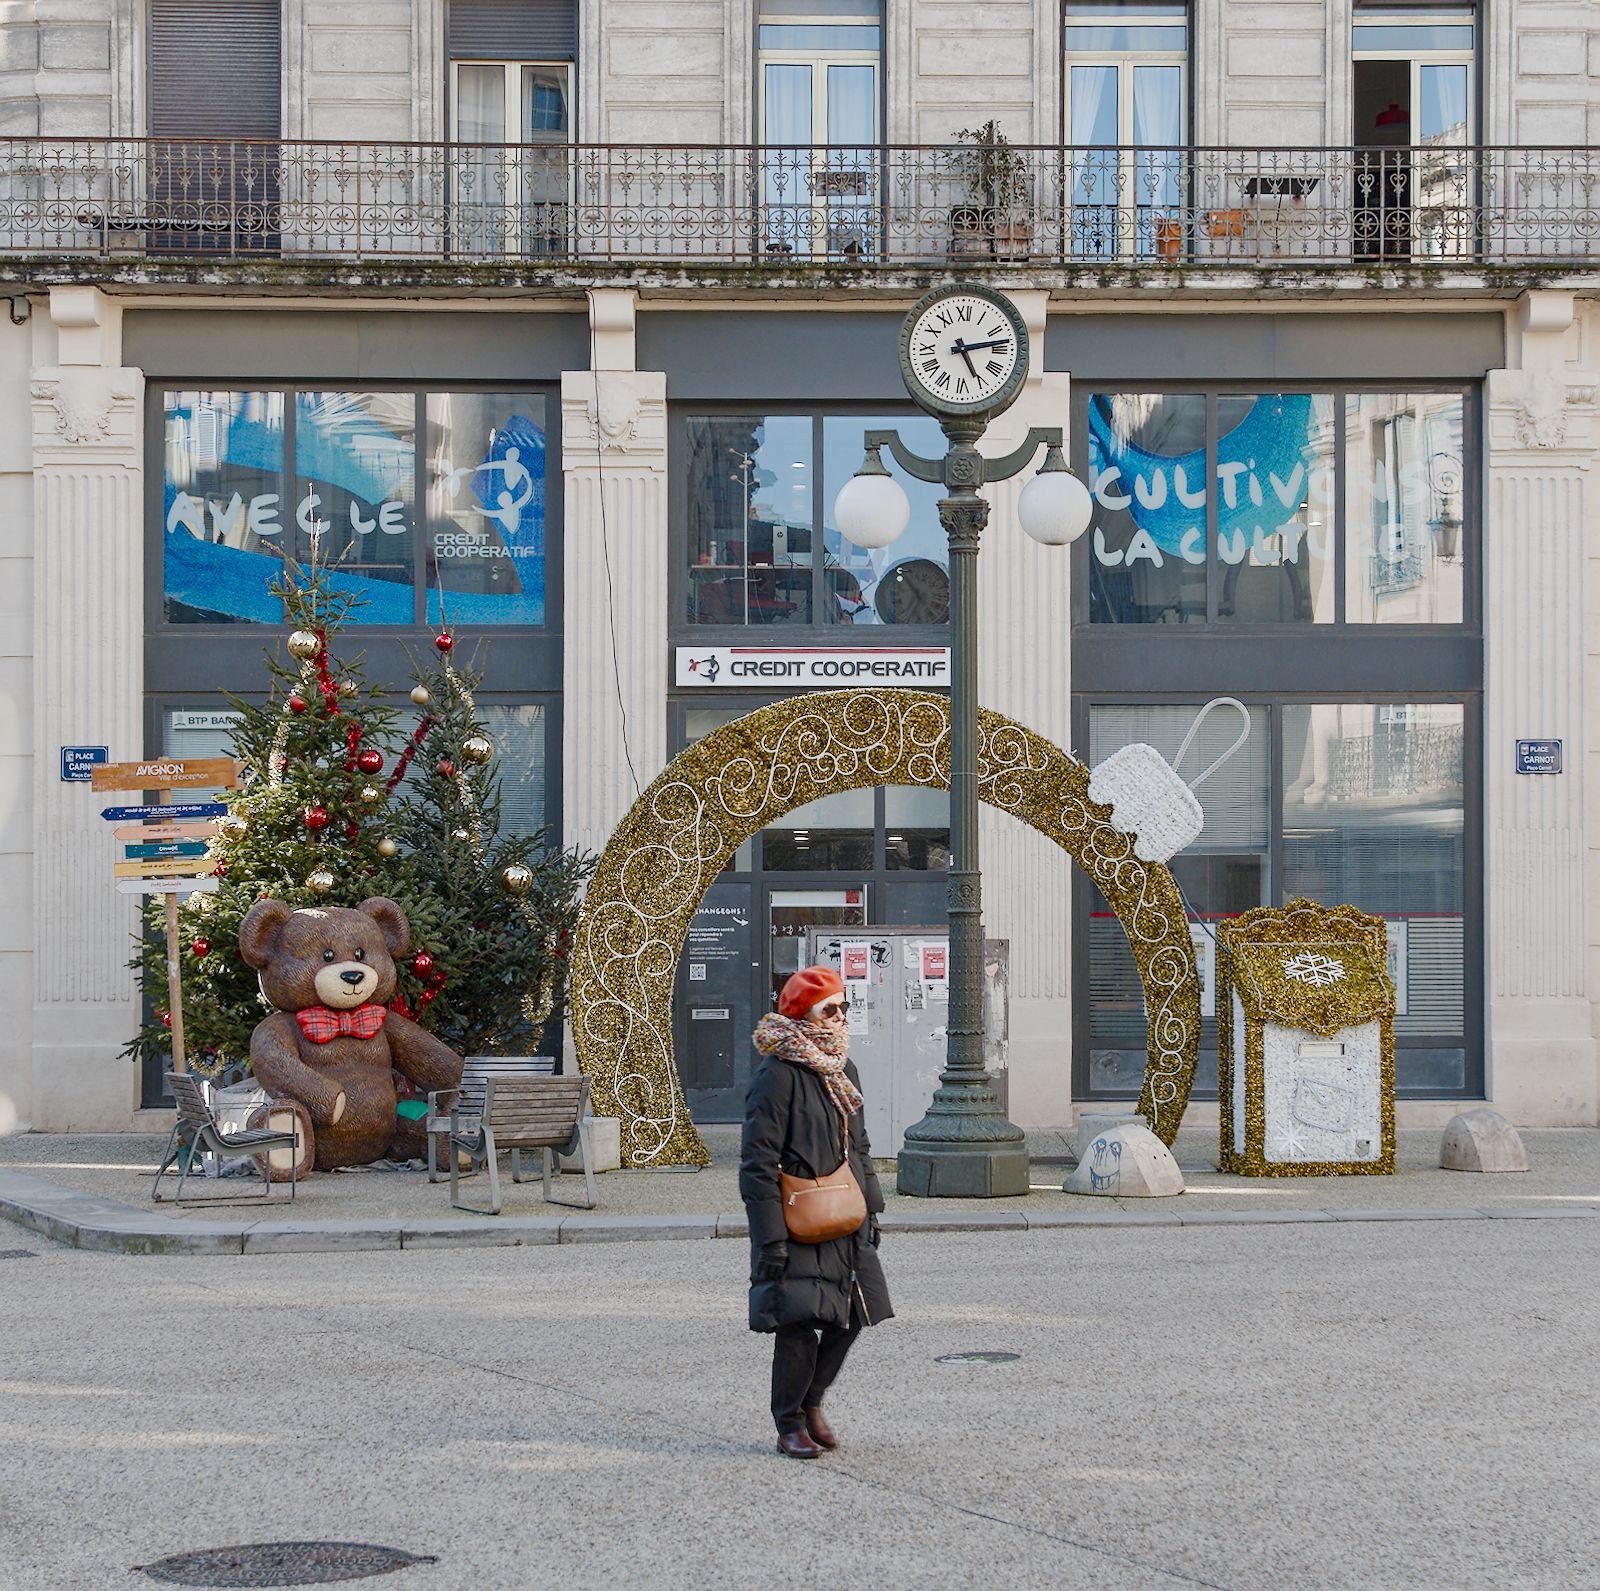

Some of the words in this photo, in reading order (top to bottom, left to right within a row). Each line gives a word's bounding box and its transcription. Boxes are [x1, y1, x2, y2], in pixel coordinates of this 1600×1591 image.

[166, 491, 331, 537] AVEC
[349, 500, 407, 535] LE
[434, 533, 490, 545] CREDIT
[434, 545, 535, 558] COOPERATIF
[1093, 526, 1165, 569] LA
[730, 660, 806, 677] CREDIT
[810, 660, 947, 677] COOPERATIF
[188, 716, 208, 725] BTP
[75, 752, 95, 760] PLACE
[1523, 755, 1555, 764] CARNOT
[68, 762, 92, 771] CARN
[135, 763, 185, 777] AVIGNON
